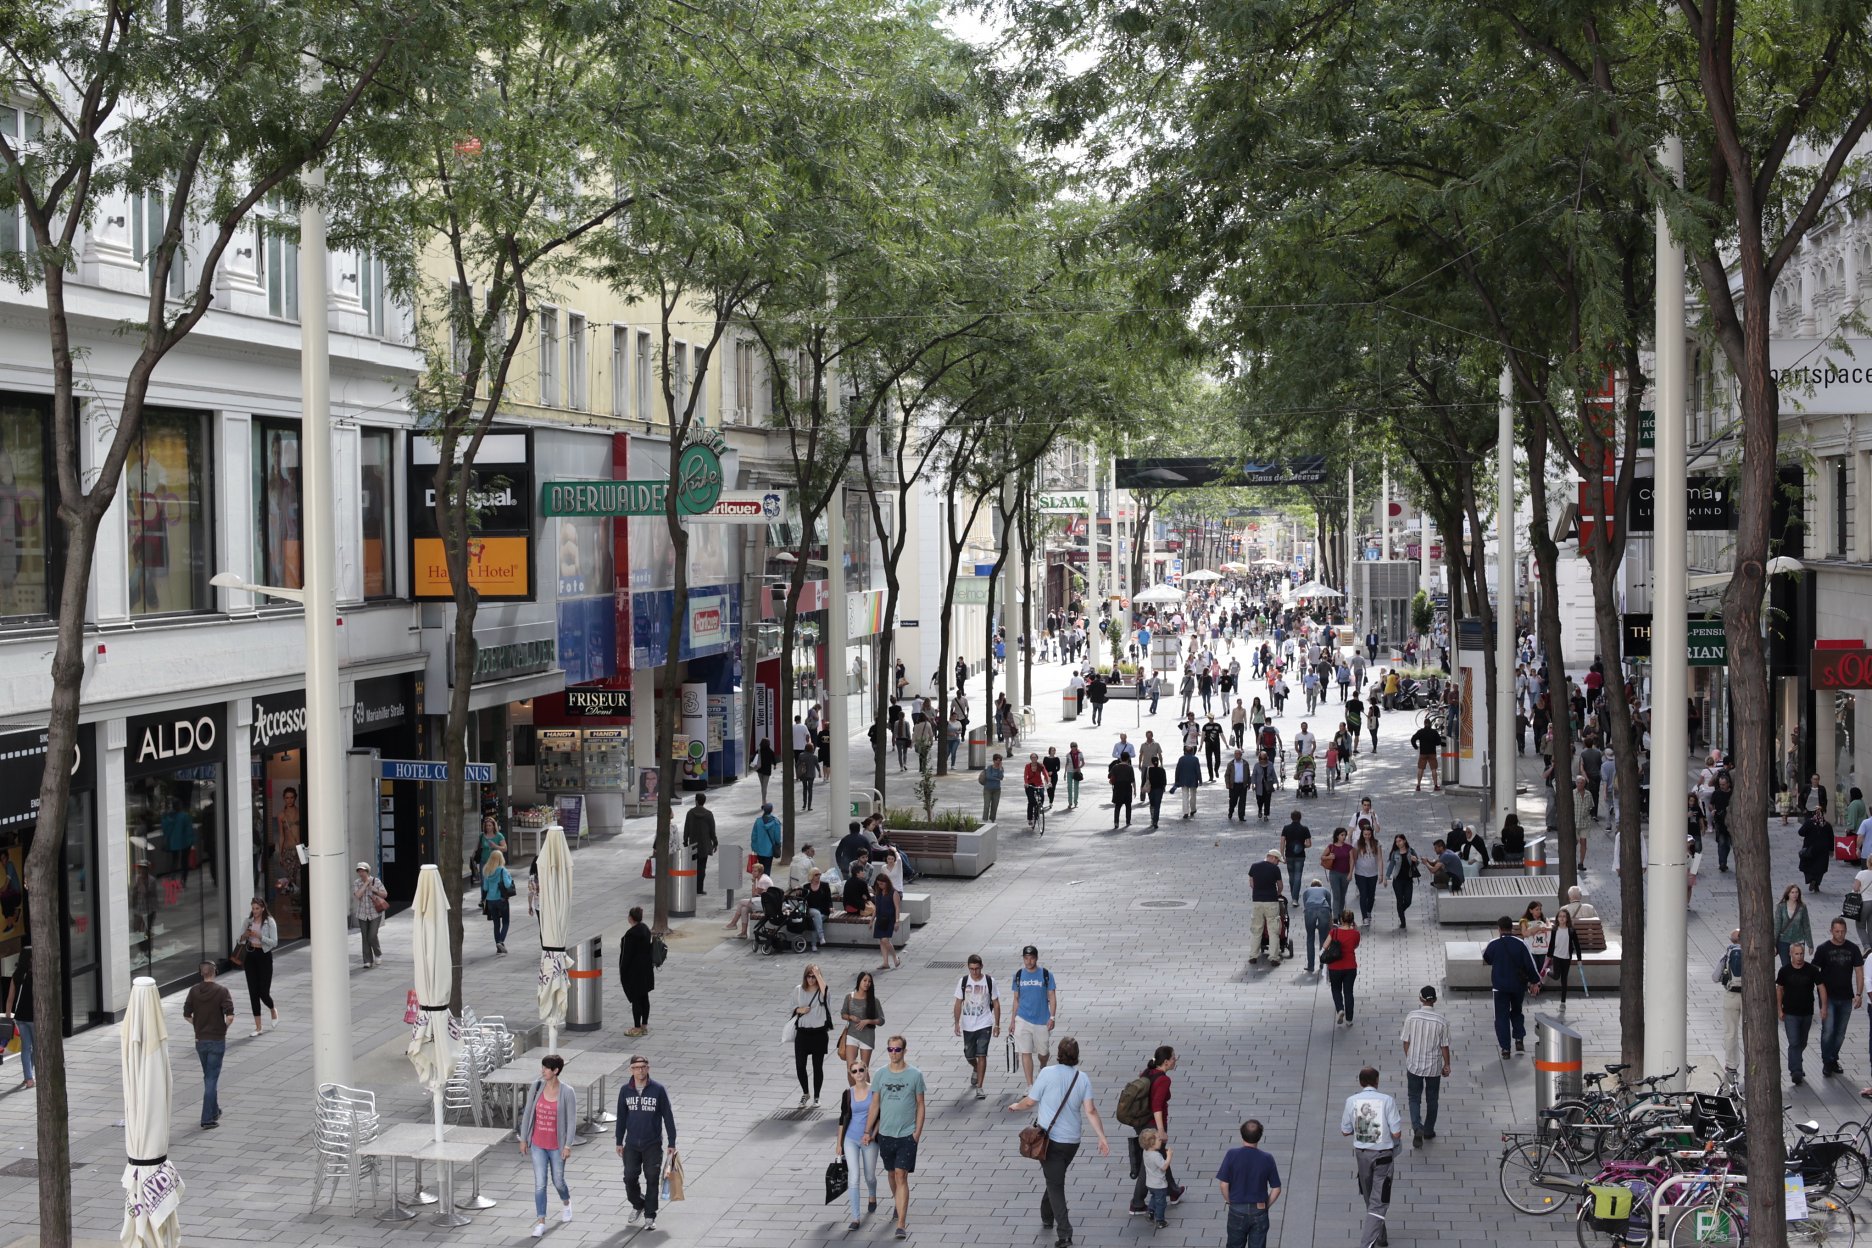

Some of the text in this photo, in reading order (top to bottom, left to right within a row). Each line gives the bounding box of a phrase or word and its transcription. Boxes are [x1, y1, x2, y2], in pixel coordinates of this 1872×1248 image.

[707, 502, 756, 514] artlauer
[1040, 496, 1088, 508] SLAM
[428, 565, 474, 578] Han
[560, 580, 584, 593] Foto
[568, 692, 627, 707] FRISEUR
[683, 691, 699, 713] 3
[756, 686, 765, 727] Wien mobil
[366, 705, 390, 722] Mariahilfer
[585, 705, 612, 716] Demi
[137, 716, 216, 763] ALDO
[395, 763, 432, 779] HOTEL
